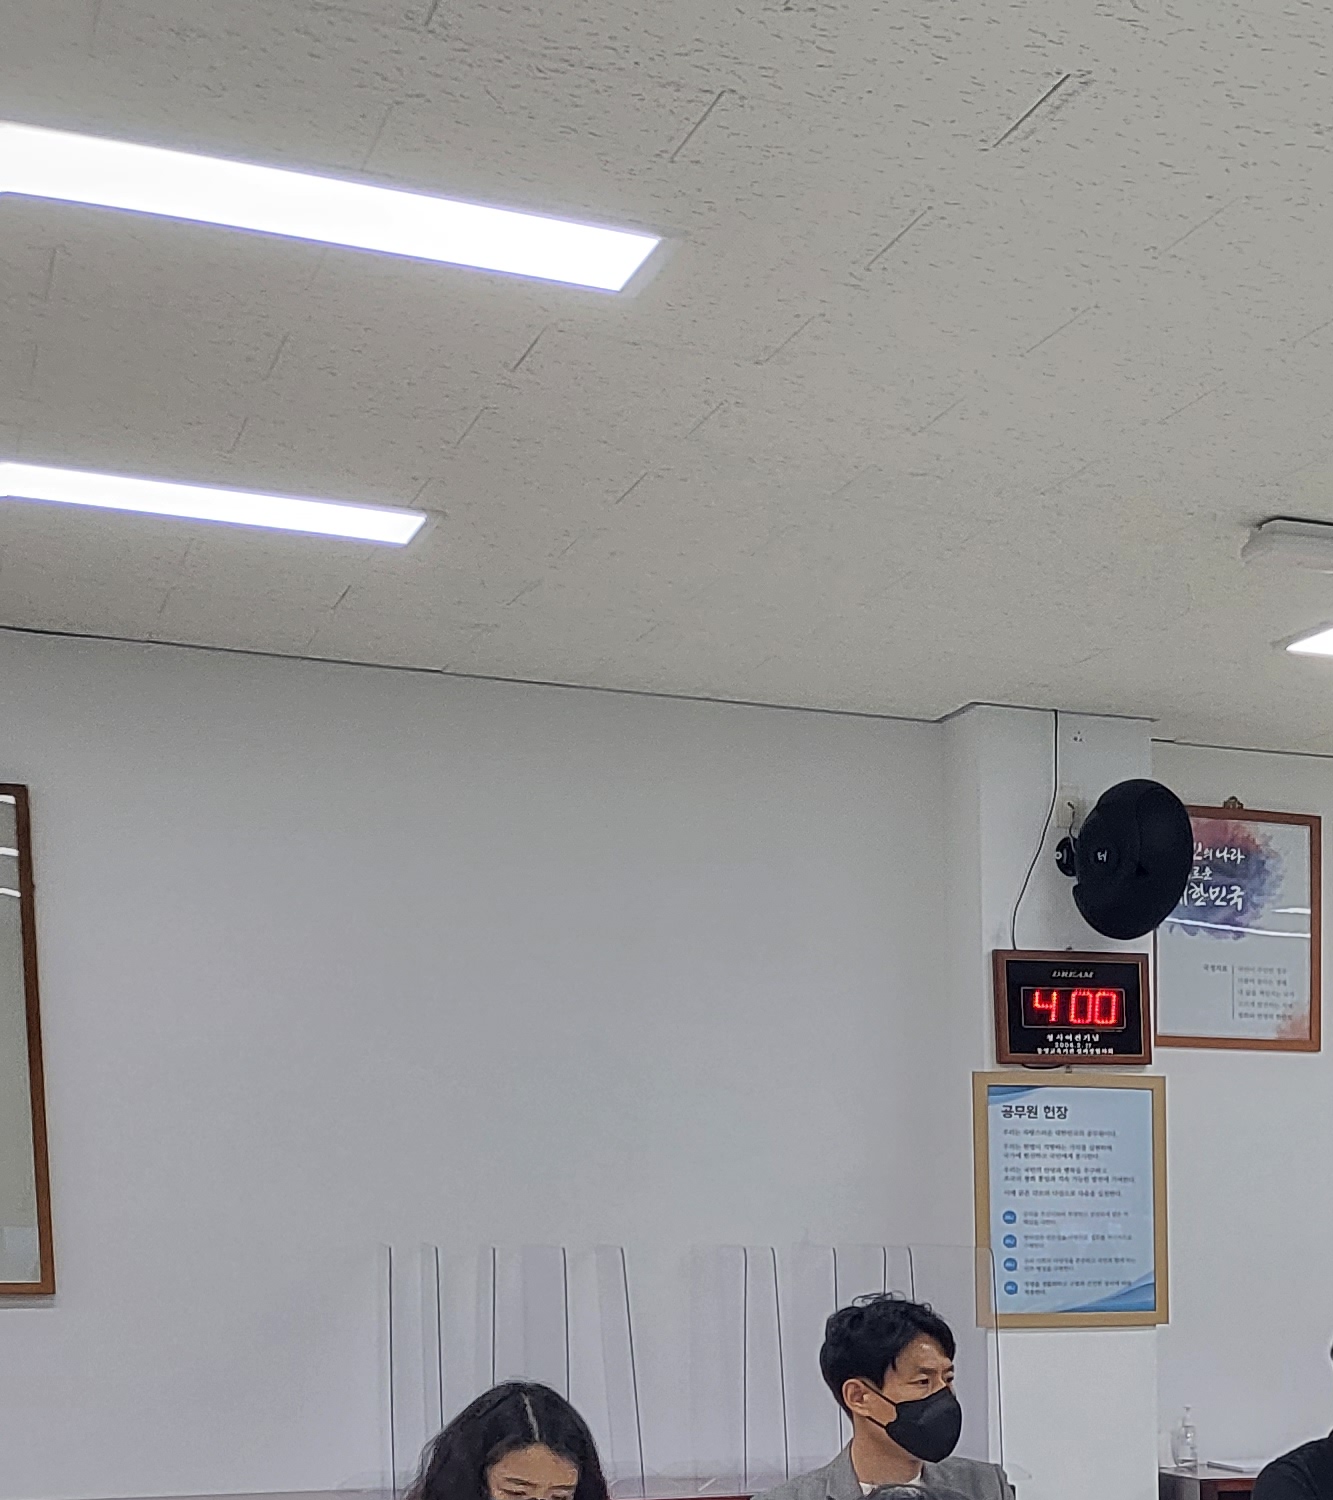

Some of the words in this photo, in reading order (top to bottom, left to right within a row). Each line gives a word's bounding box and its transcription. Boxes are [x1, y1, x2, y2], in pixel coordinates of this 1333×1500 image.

[1215, 847, 1245, 864] 나라
[1187, 866, 1213, 880] 로운
[1001, 1104, 1039, 1119] 공무원
[1043, 1105, 1069, 1120] 헌장
